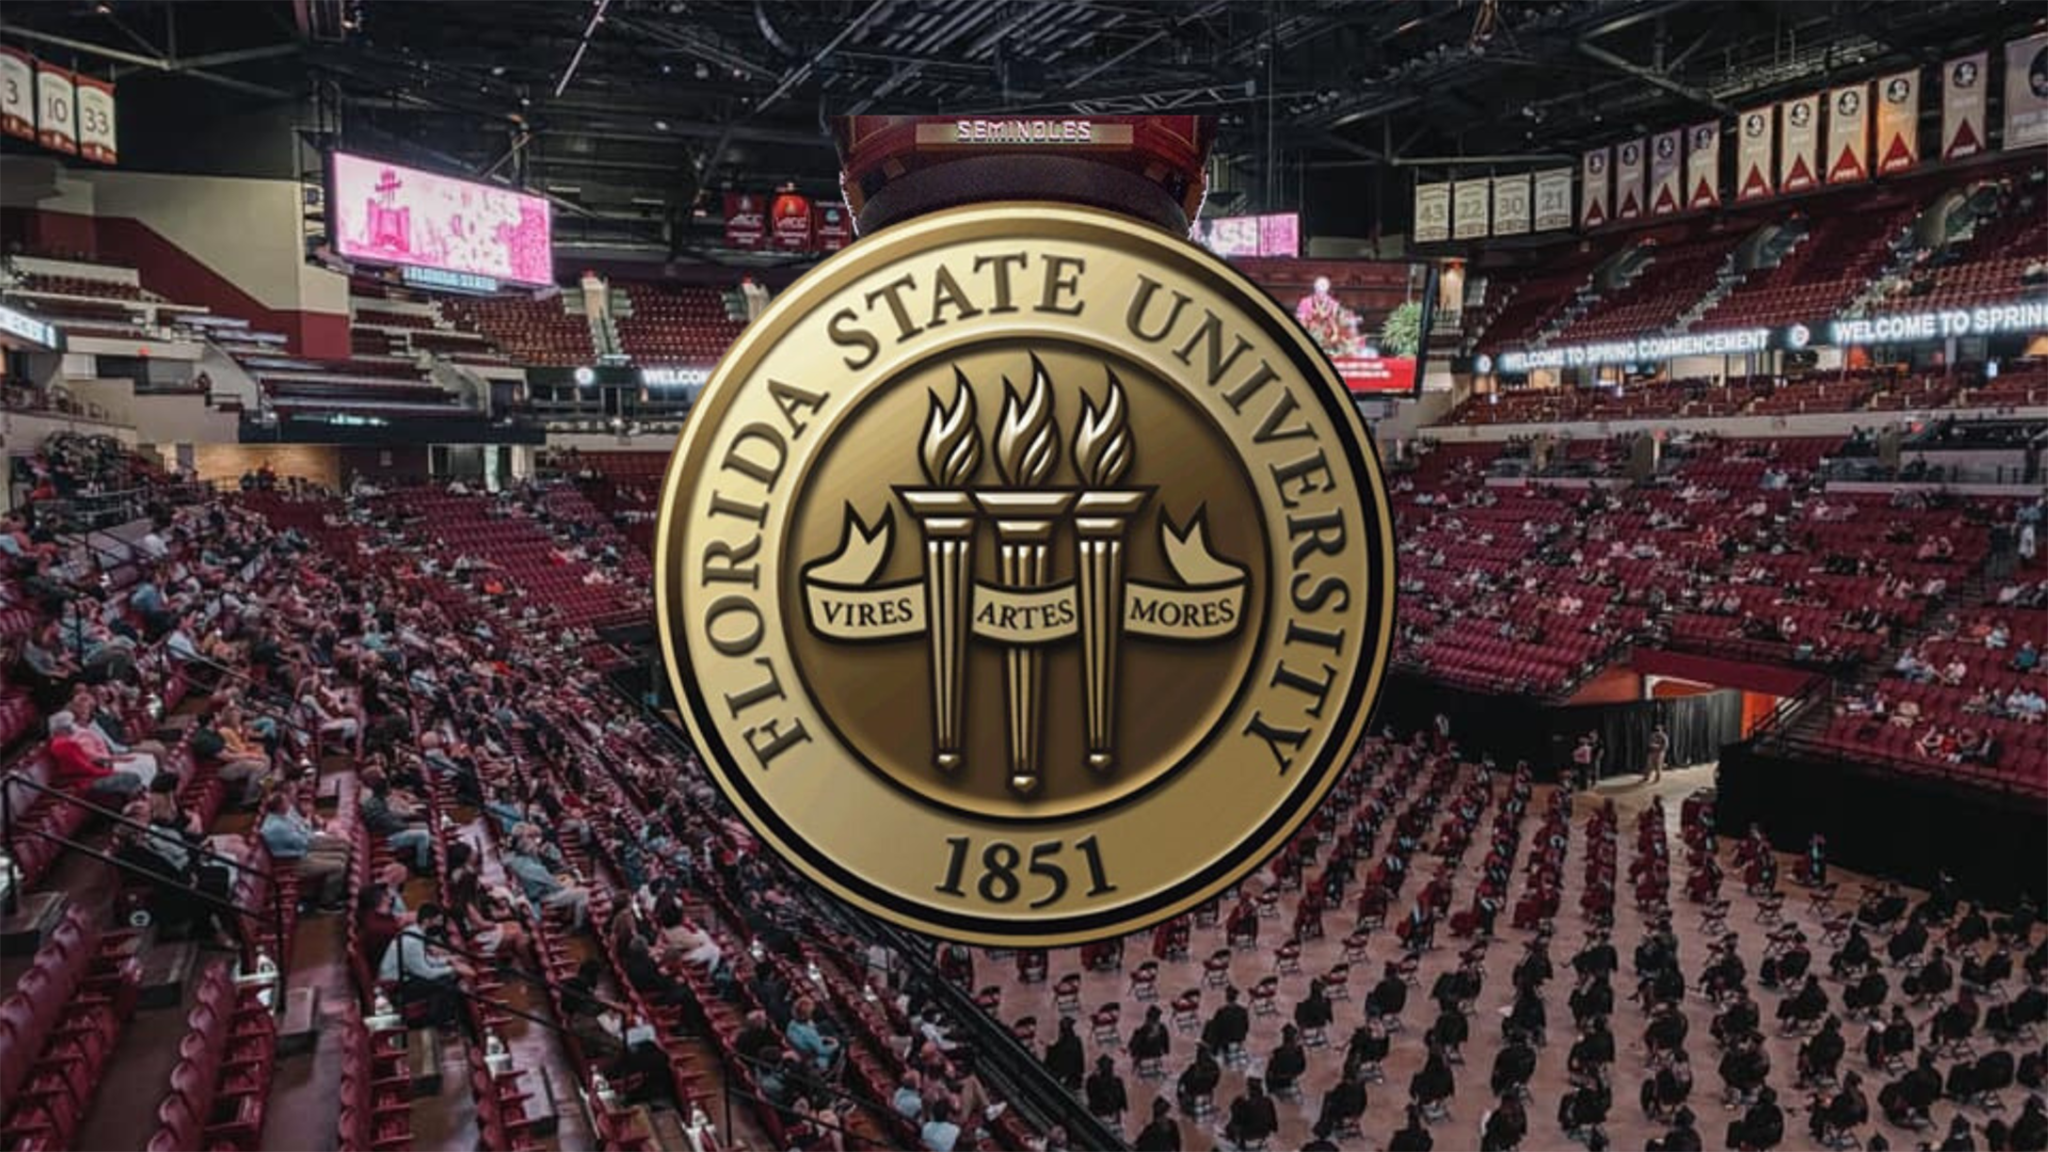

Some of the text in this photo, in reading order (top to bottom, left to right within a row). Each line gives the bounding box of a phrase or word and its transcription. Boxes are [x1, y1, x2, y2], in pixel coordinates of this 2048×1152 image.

[6, 79, 19, 105] 3
[48, 97, 69, 123] 10
[85, 107, 109, 135] 33
[957, 120, 1091, 142] SEMINOLES
[1458, 201, 1483, 220] 22
[1834, 317, 1936, 342] WELCOME
[1940, 311, 1970, 334] TO
[1504, 328, 1769, 371] WELCOME TO SPRING COMMENCEMENT
